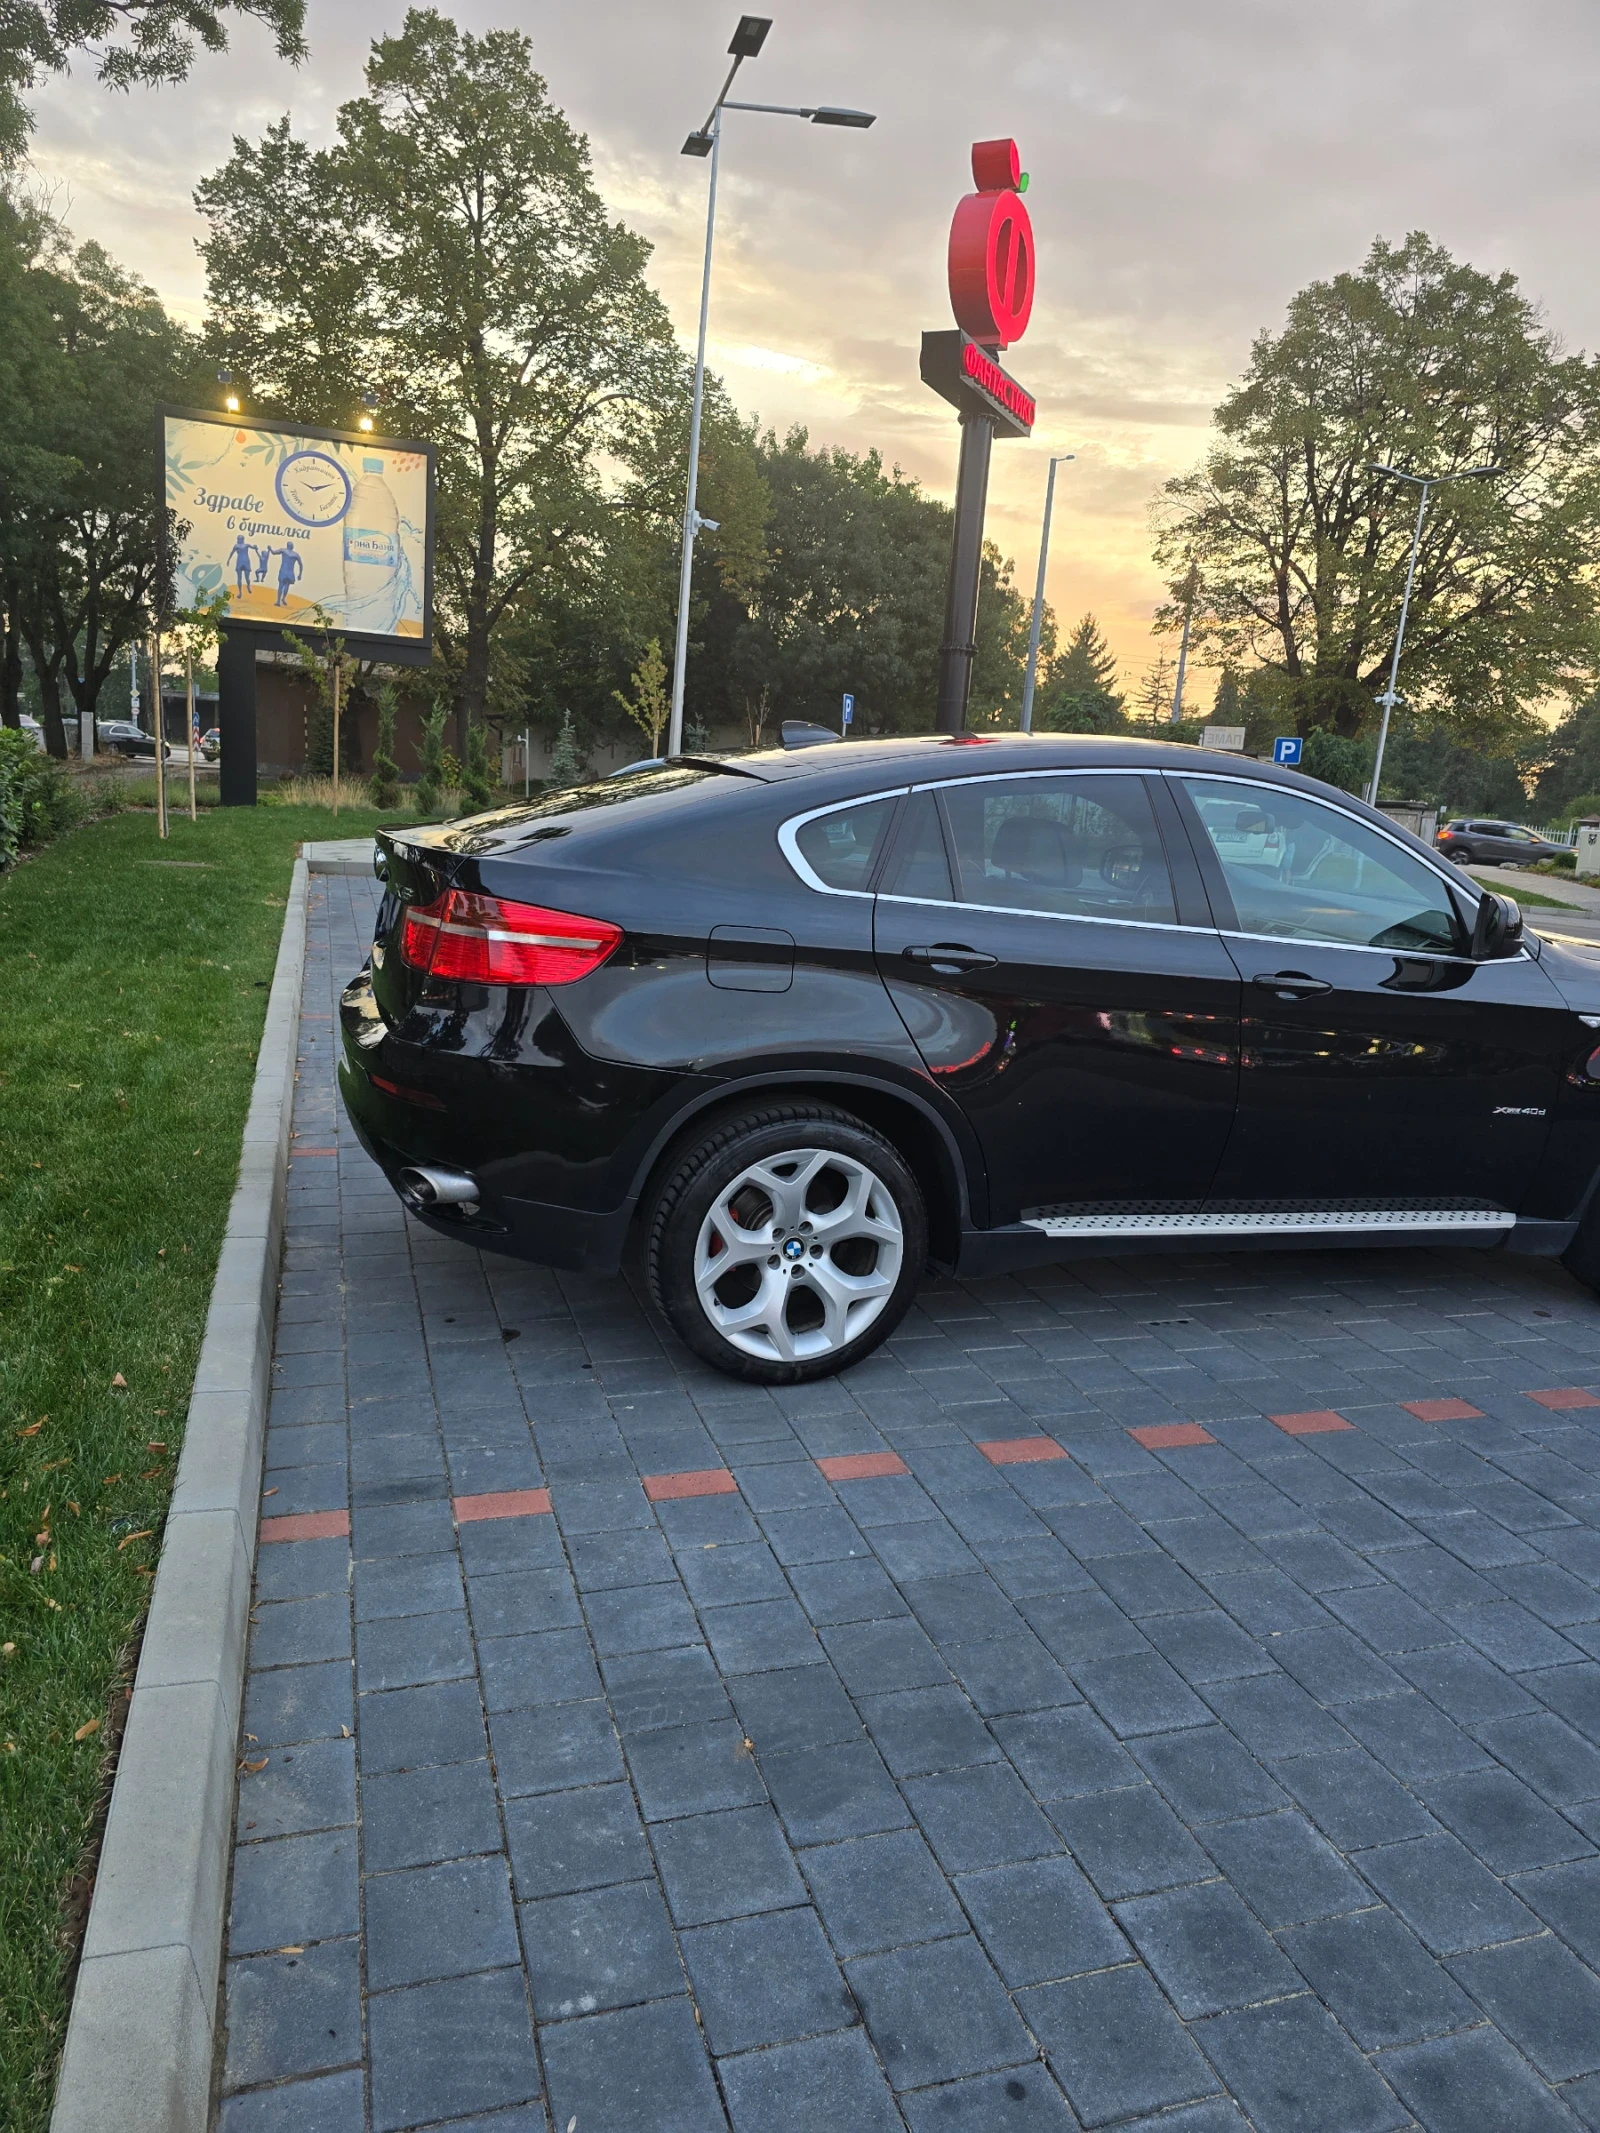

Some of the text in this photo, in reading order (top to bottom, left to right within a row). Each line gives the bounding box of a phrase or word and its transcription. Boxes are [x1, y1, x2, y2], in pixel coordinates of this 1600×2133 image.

[964, 343, 1035, 427] ФАНТАСТИКО
[193, 487, 264, 513] Здраве
[226, 515, 311, 540] в бутилка
[845, 699, 851, 720] P
[1280, 741, 1296, 761] P
